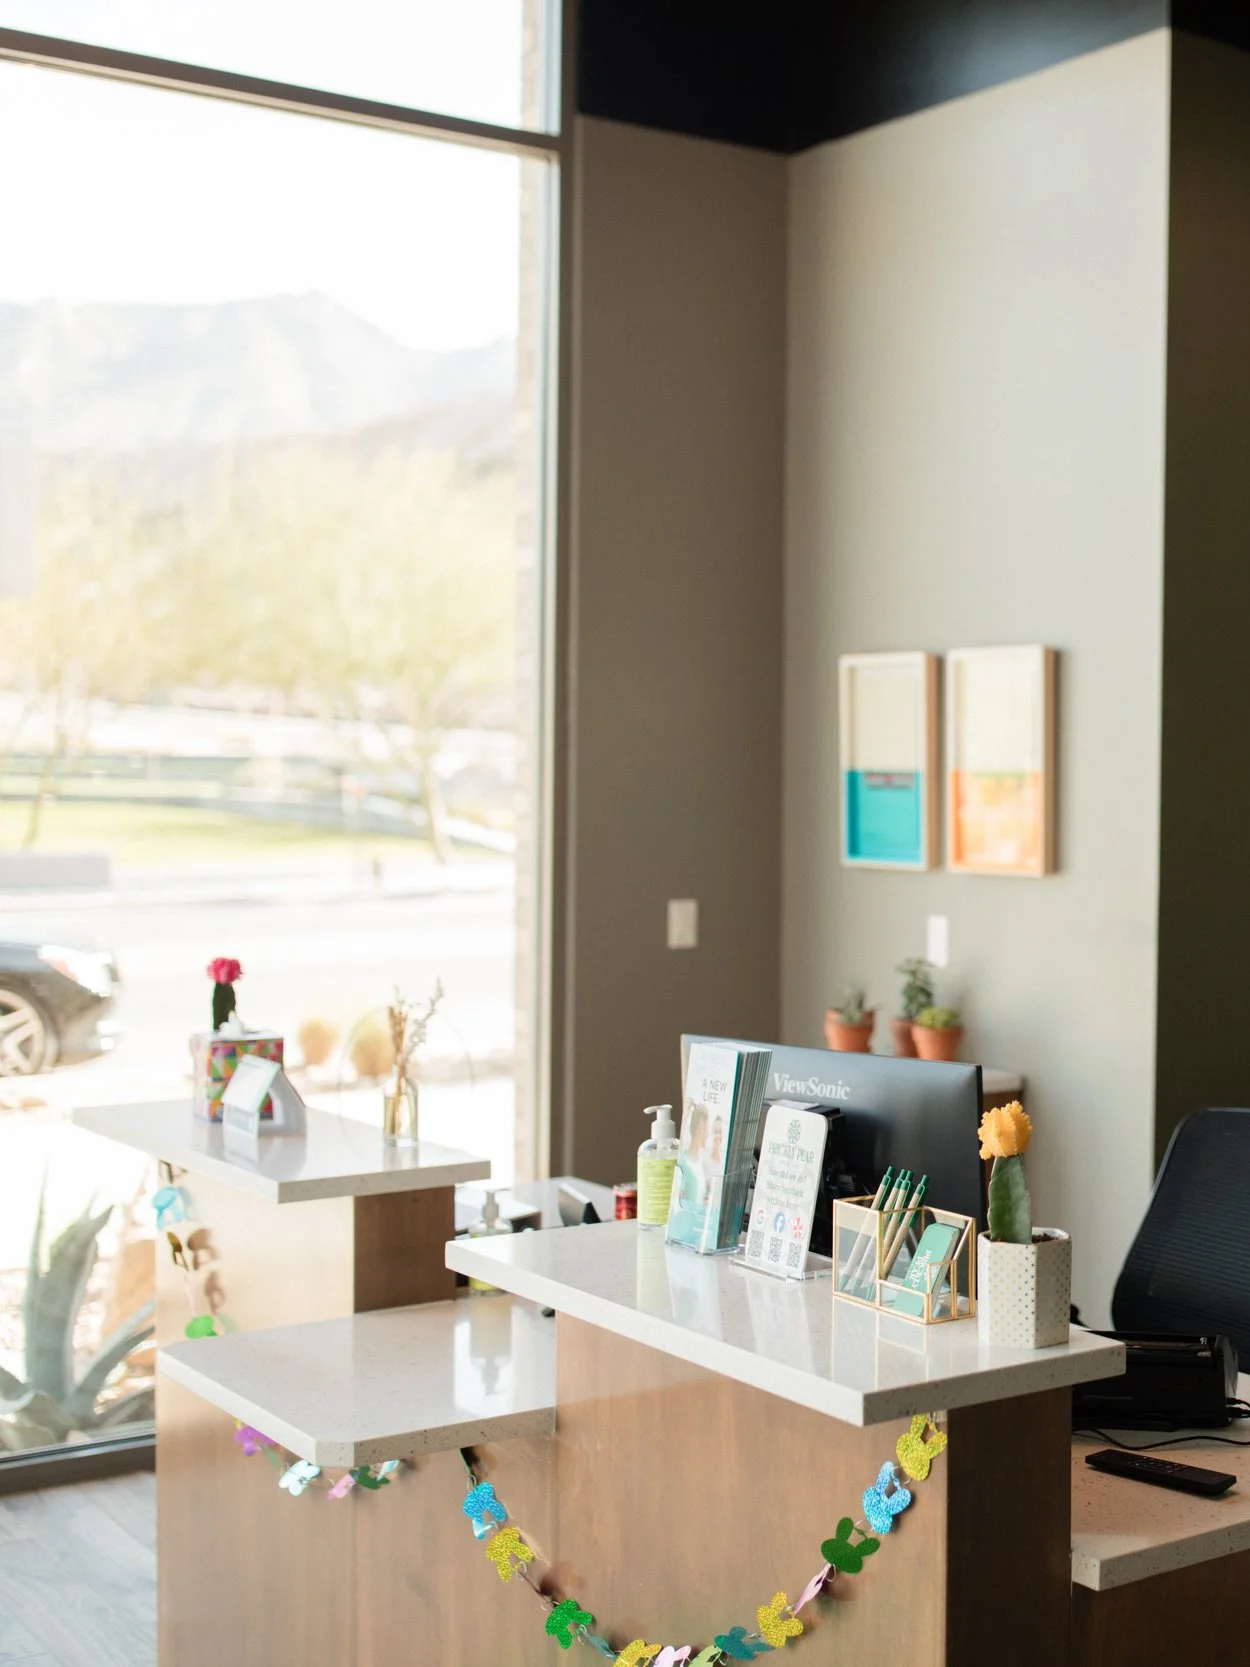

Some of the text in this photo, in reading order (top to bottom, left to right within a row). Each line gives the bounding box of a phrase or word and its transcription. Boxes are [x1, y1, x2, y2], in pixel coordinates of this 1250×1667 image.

[702, 1078, 728, 1093] A NEW
[773, 1072, 850, 1100] ViewSonic
[797, 1147, 815, 1164] PEAR
